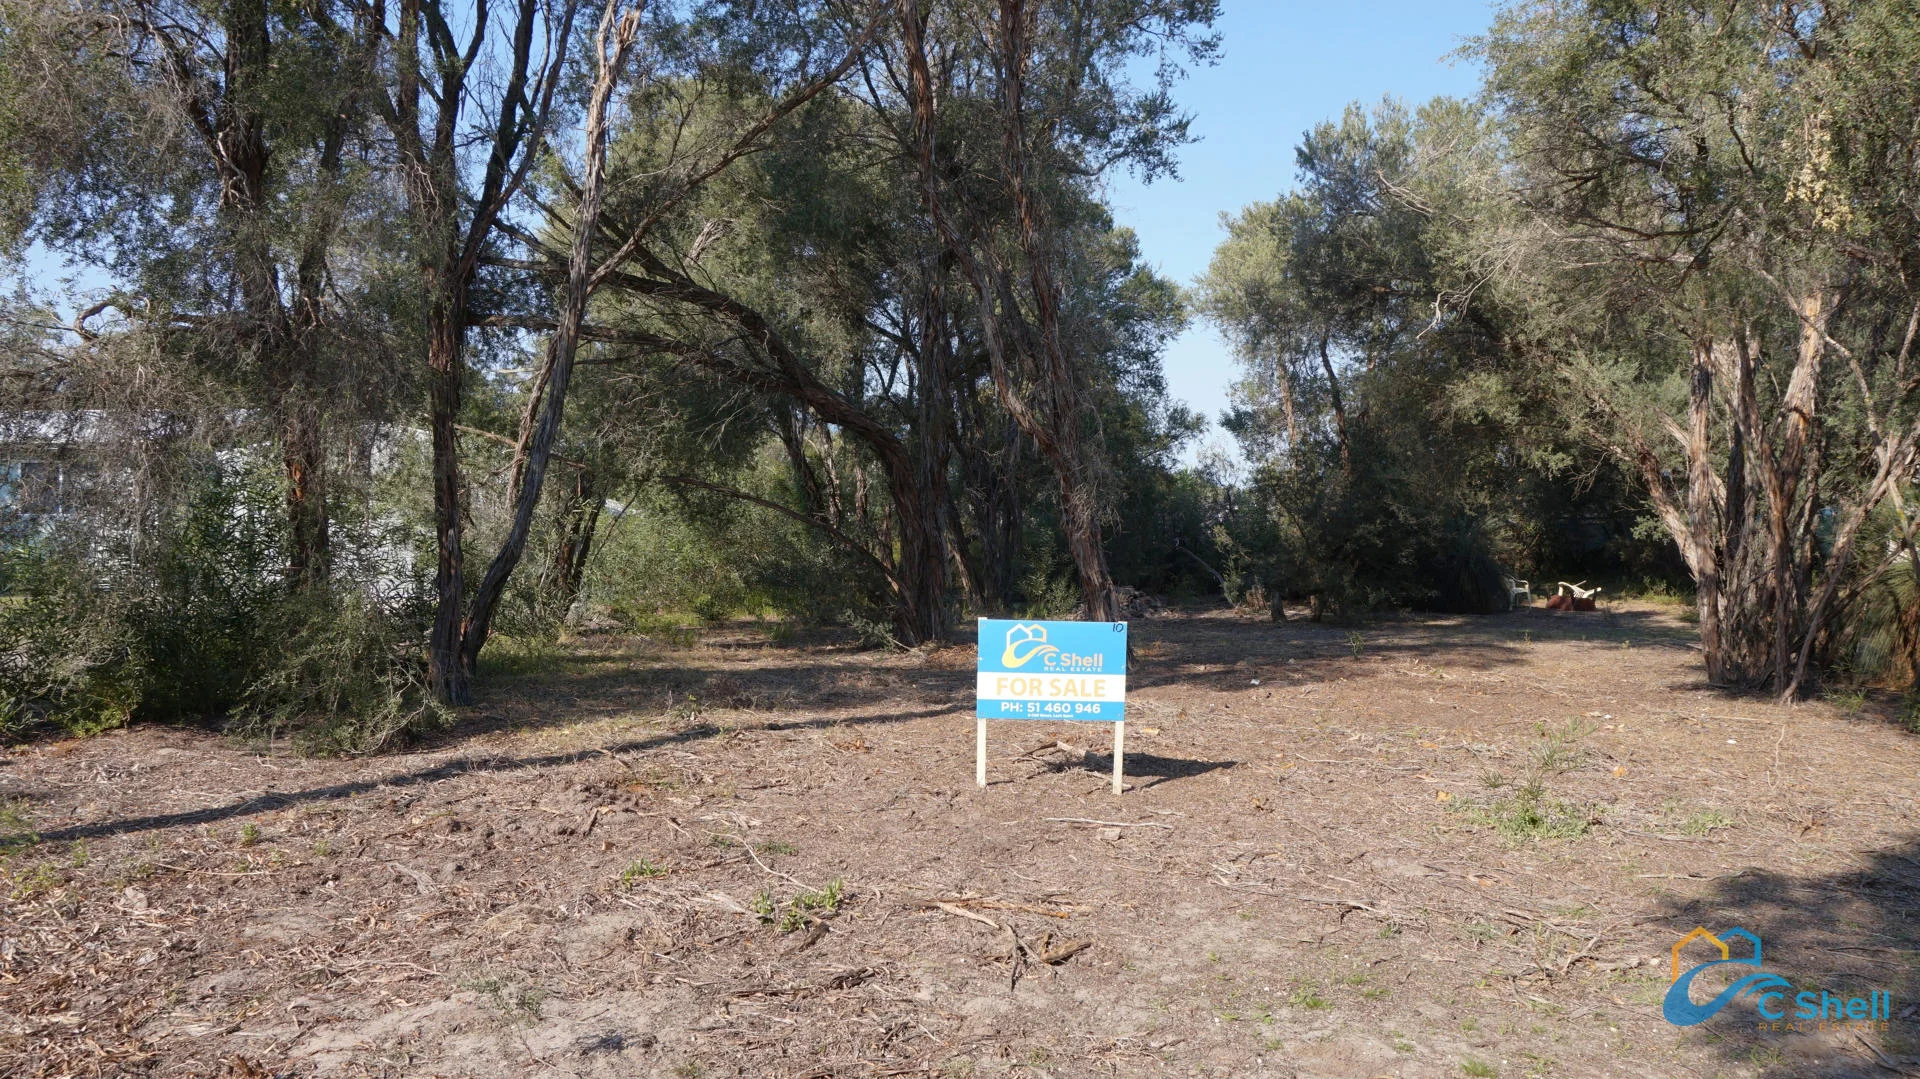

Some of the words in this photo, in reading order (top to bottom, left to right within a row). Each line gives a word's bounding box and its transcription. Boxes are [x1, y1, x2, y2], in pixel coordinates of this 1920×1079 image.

[1112, 623, 1124, 633] 10
[1043, 653, 1057, 667] C
[1060, 653, 1103, 667] Shell
[996, 677, 1043, 696] FOR
[1050, 678, 1106, 698] SALE
[1001, 702, 1023, 713] PH:
[1027, 702, 1040, 713] 51
[1044, 703, 1071, 713] 460
[1075, 703, 1101, 714] 946
